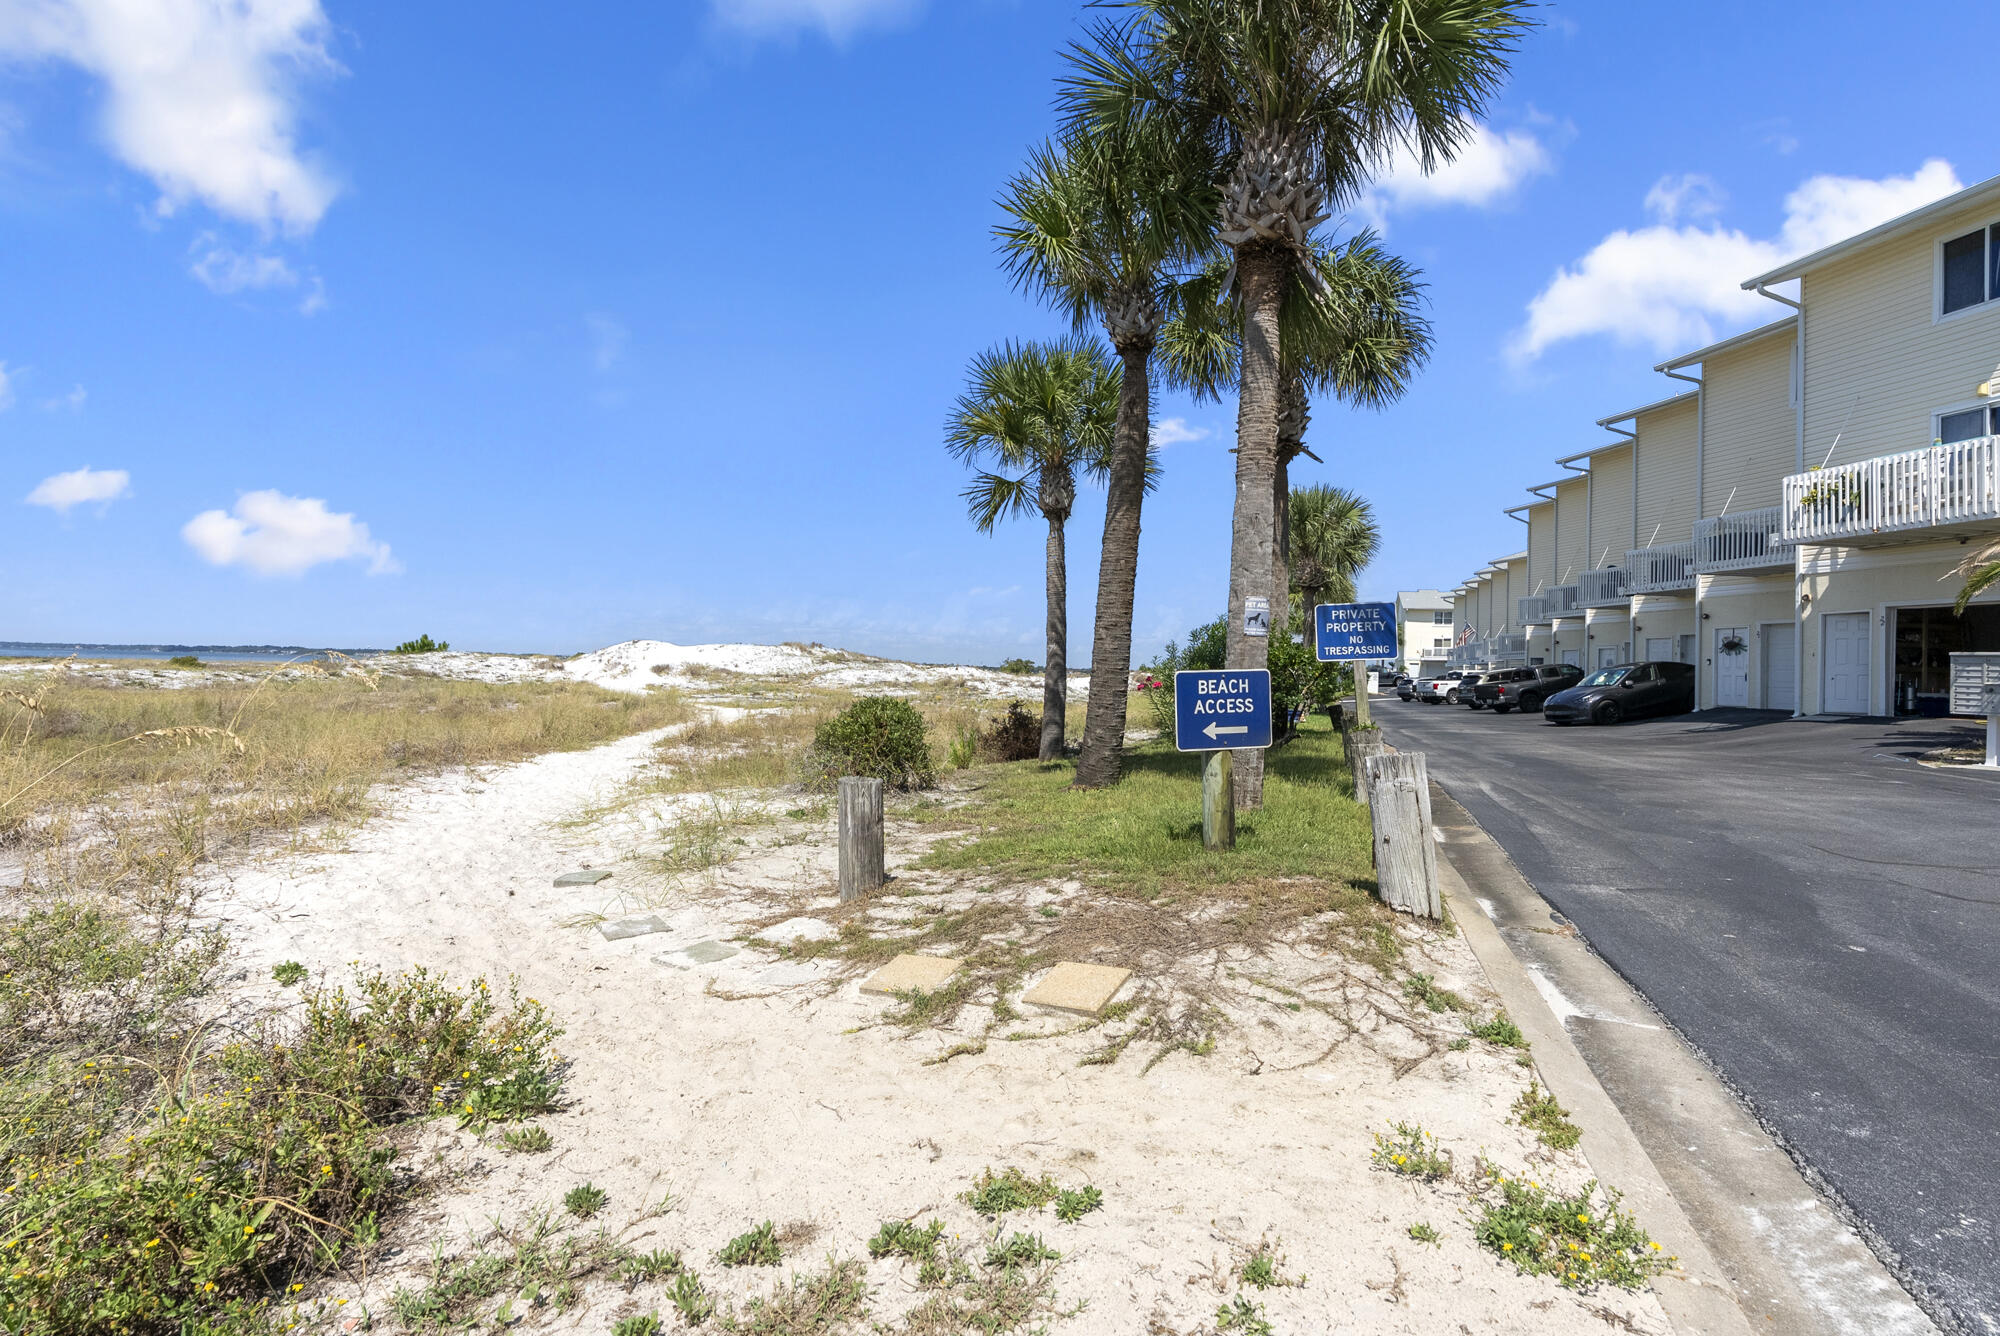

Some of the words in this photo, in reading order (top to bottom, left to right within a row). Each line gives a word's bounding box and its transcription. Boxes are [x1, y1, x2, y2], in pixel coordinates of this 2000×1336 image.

[1331, 608, 1380, 620] PRIVATE
[1326, 620, 1387, 633] PROPERTY
[1349, 635, 1364, 644] NO
[1324, 645, 1390, 656] TRESPASSING
[1198, 678, 1249, 695] BEACH
[1194, 698, 1254, 715] ACCESS
